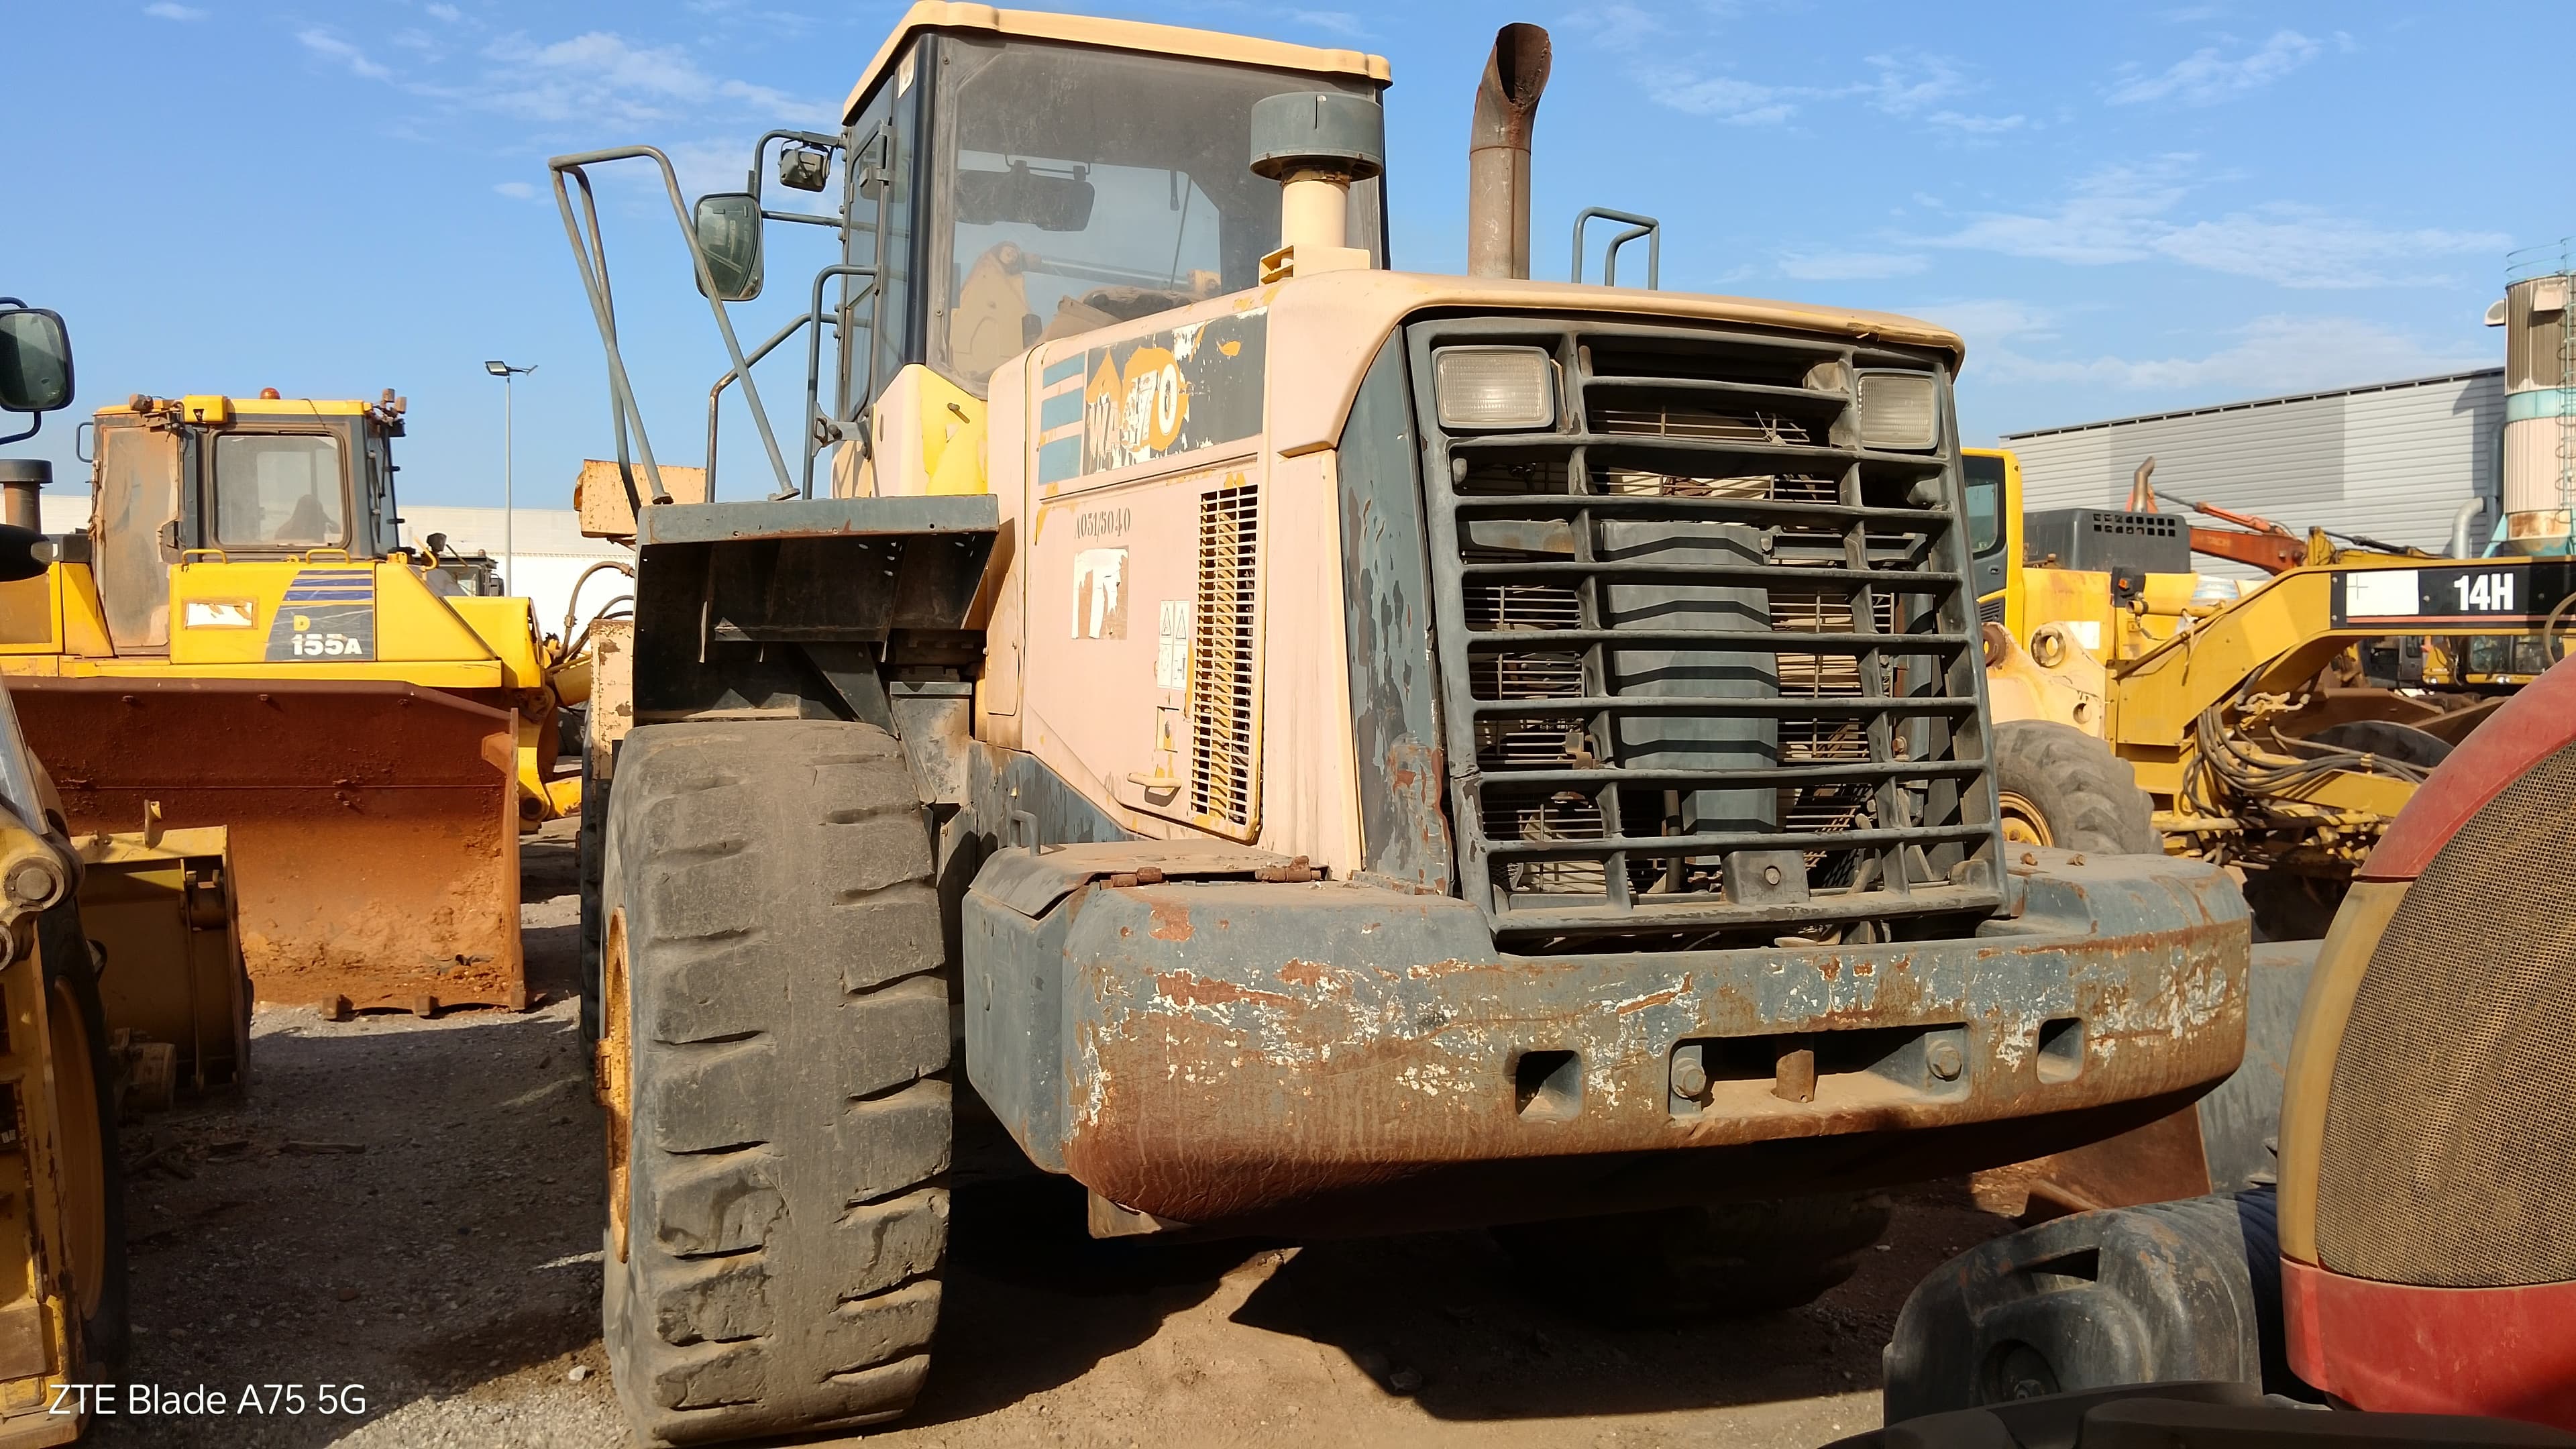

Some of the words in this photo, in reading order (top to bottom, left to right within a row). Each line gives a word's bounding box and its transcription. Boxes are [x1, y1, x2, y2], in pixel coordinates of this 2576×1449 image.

[2453, 572, 2514, 611] 14H
[293, 614, 311, 631] D
[290, 633, 363, 655] 155A
